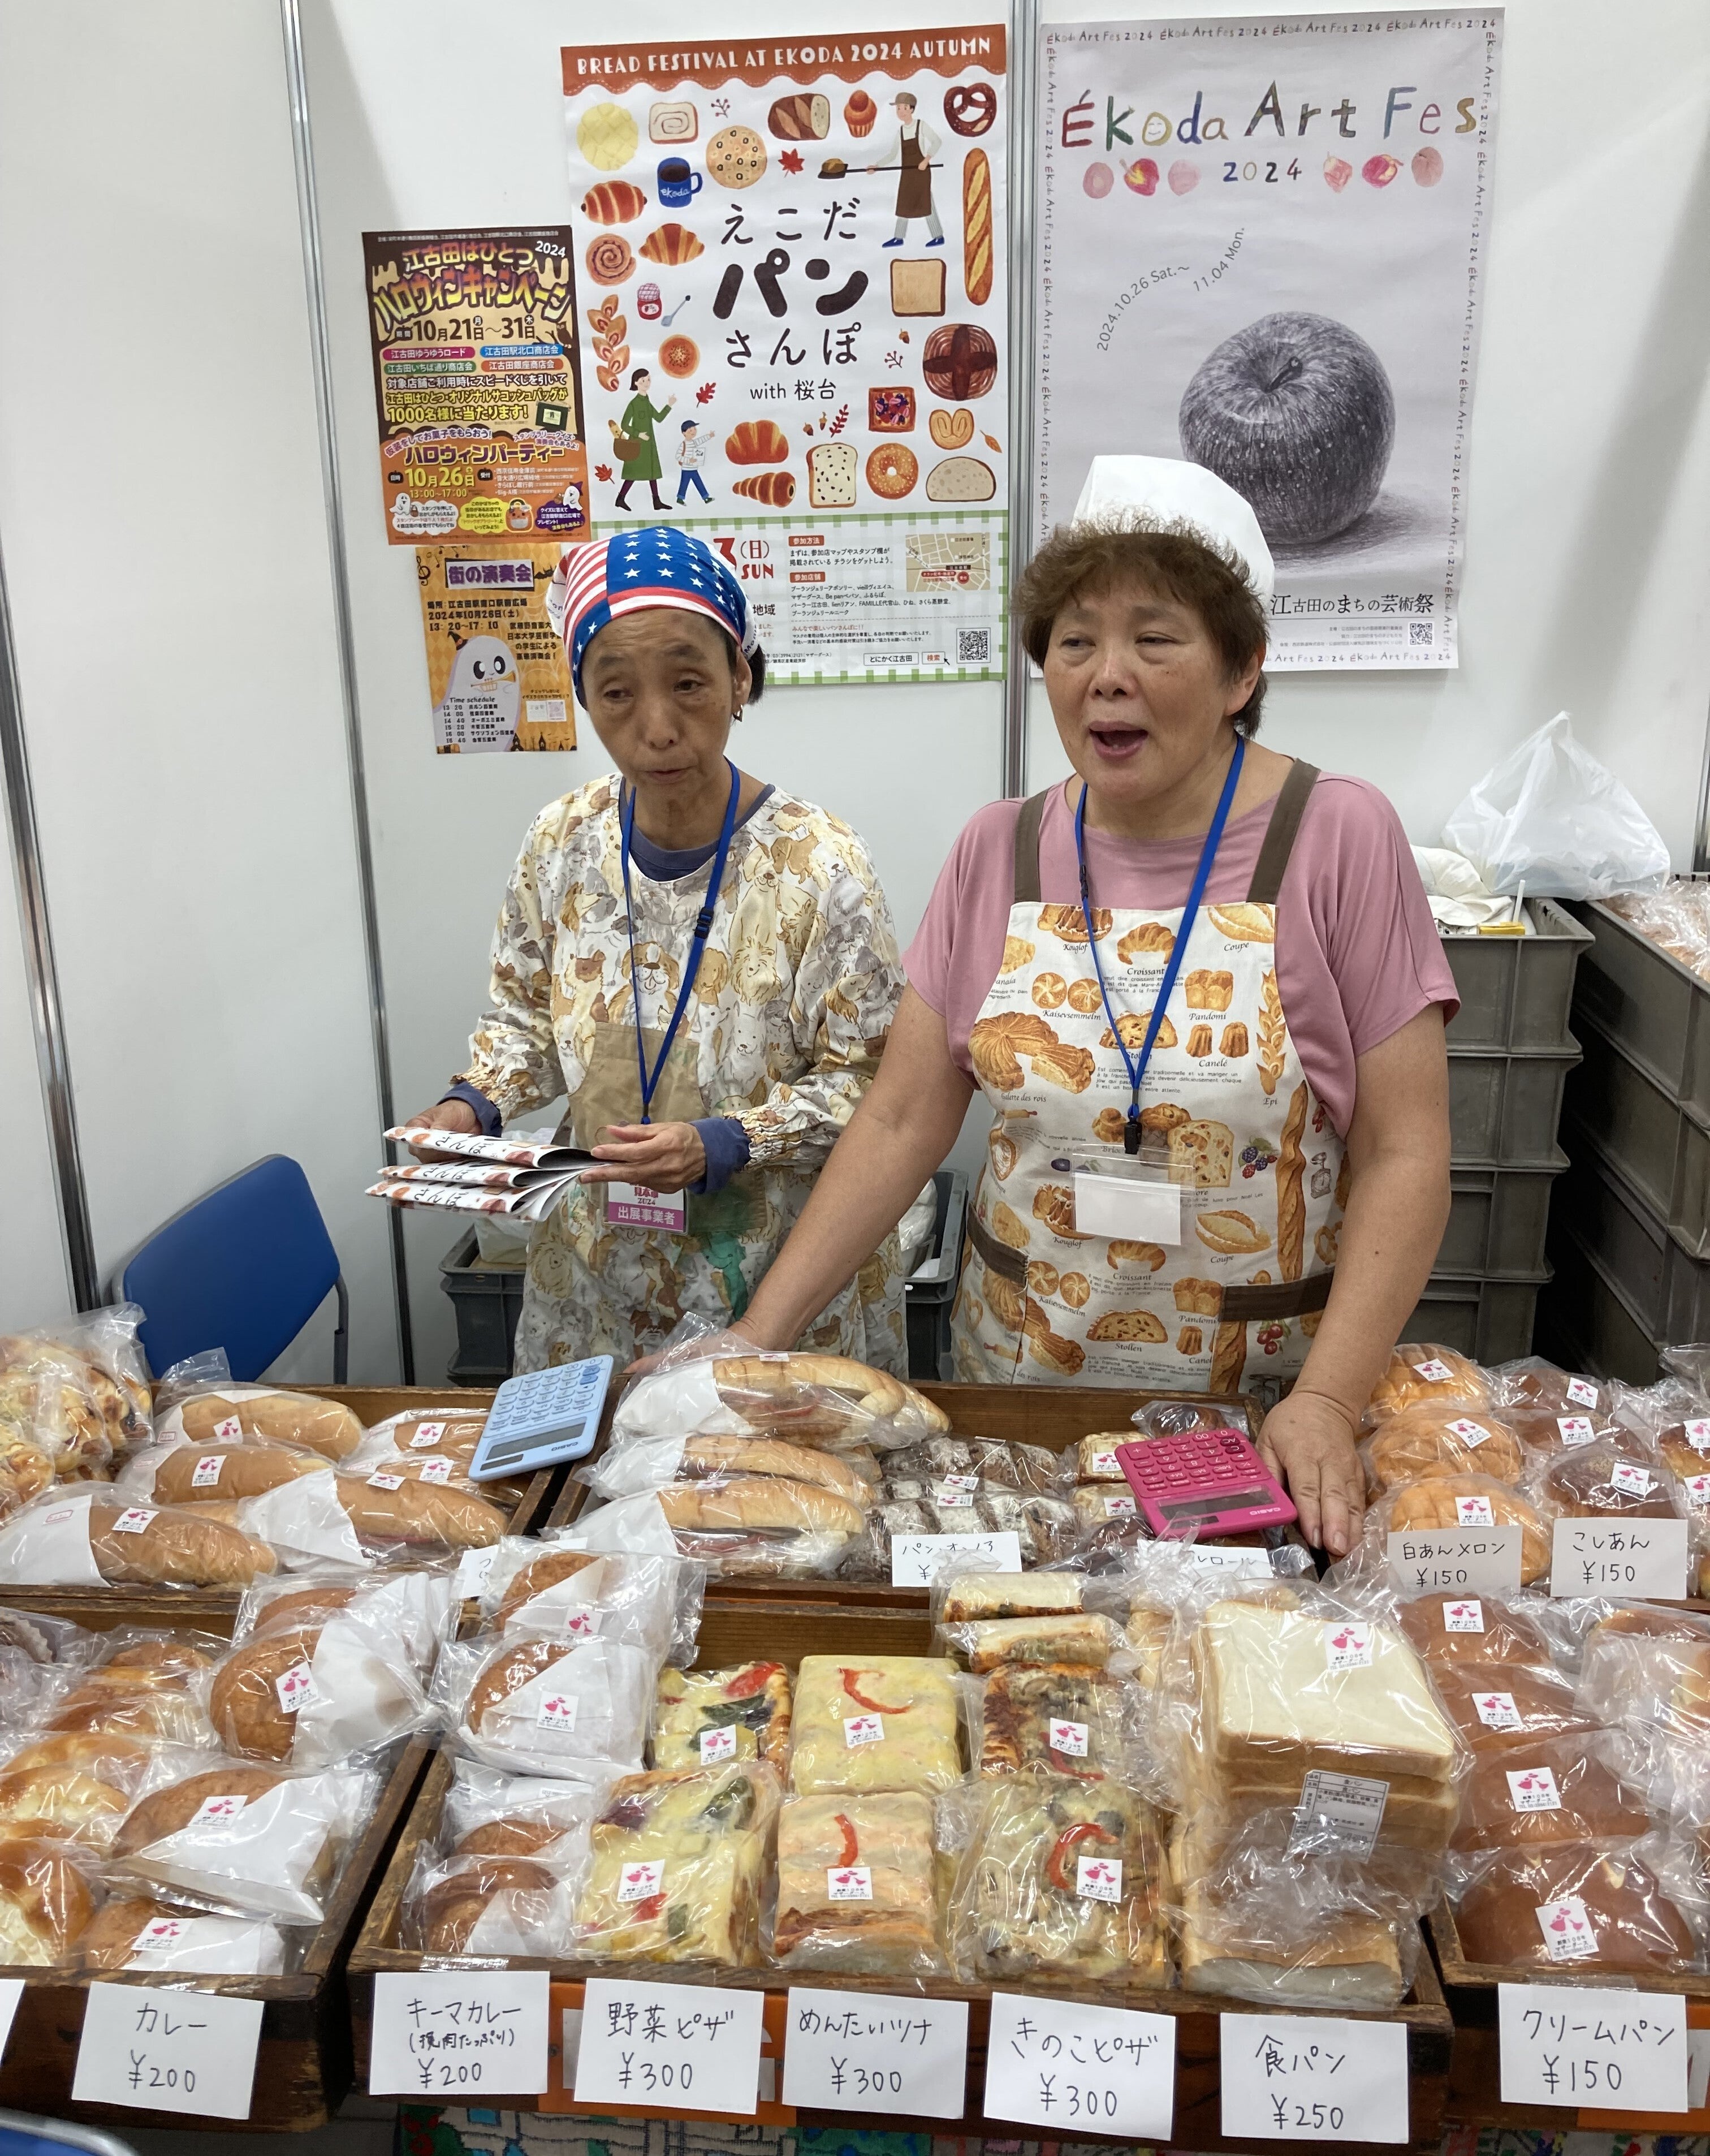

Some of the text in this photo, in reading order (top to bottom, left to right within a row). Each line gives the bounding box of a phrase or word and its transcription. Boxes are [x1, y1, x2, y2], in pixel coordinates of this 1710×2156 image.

[1079, 31, 1099, 41] Art
[1124, 31, 1152, 41] 2024
[1193, 26, 1213, 37] Art
[1238, 26, 1267, 37] 2024
[1419, 18, 1441, 29] Art
[1467, 19, 1496, 29] 2024
[577, 37, 990, 75] BREAD FESTIVAL AT EKODA 2024 AUTUMN
[1061, 80, 1477, 151] Ékoda Art Fes
[1223, 158, 1303, 183] 2024
[660, 186, 691, 199] ekoda
[721, 197, 861, 245] えこだ
[403, 242, 534, 272] 江古田はひとつ
[535, 240, 566, 257] 2024
[1193, 228, 1244, 291] 11.04 Mon.
[712, 248, 869, 319] パン
[373, 268, 571, 330] ハロウィンキャンペーン
[1097, 277, 1148, 351] 2024.10.26
[391, 345, 559, 359] 江古田ゆうゆうロード 江古田駅北口商店会
[726, 322, 861, 368] さんぽ
[387, 360, 555, 373] 江古田いちば通り商店会 江古田銀座商店会
[387, 374, 567, 389] 対象店舗ご利用時にスピードくじを引いて
[750, 379, 837, 401] with 桜台
[404, 445, 564, 465] ハロウィンパーティー
[448, 564, 532, 584] 街の演奏会
[741, 563, 774, 580] SUN
[752, 604, 776, 616] 地域
[1270, 593, 1435, 615] 江古田のまちの芸術祭
[870, 654, 912, 663] とにかく江古田
[1380, 652, 1400, 661] Art
[1063, 943, 1089, 954] Kouglof
[1224, 942, 1250, 952] Coupe
[1189, 1012, 1227, 1021] Pandomi
[1199, 1058, 1228, 1067] Canelé
[1263, 1097, 1278, 1107] Epi
[435, 1136, 494, 1154] さんぽ
[618, 1206, 675, 1225] 出展事業者
[1053, 1236, 1082, 1248] Kouglof
[1211, 1255, 1234, 1265] Coupe
[1115, 1343, 1142, 1352] Stollen
[551, 1442, 578, 1451] CASIO
[1403, 1542, 1505, 1560] 白あんメロン
[1573, 1531, 1649, 1552] こしあん
[136, 2001, 208, 2036] カレー
[407, 1998, 522, 2028] キーマカレー
[607, 2002, 735, 2042] 野菜ピザ
[800, 2008, 932, 2045] めんたいツナ
[1523, 2010, 1676, 2046] クリームパン
[1011, 2015, 1159, 2066] きのこピザ
[1255, 2034, 1346, 2077] 食パン
